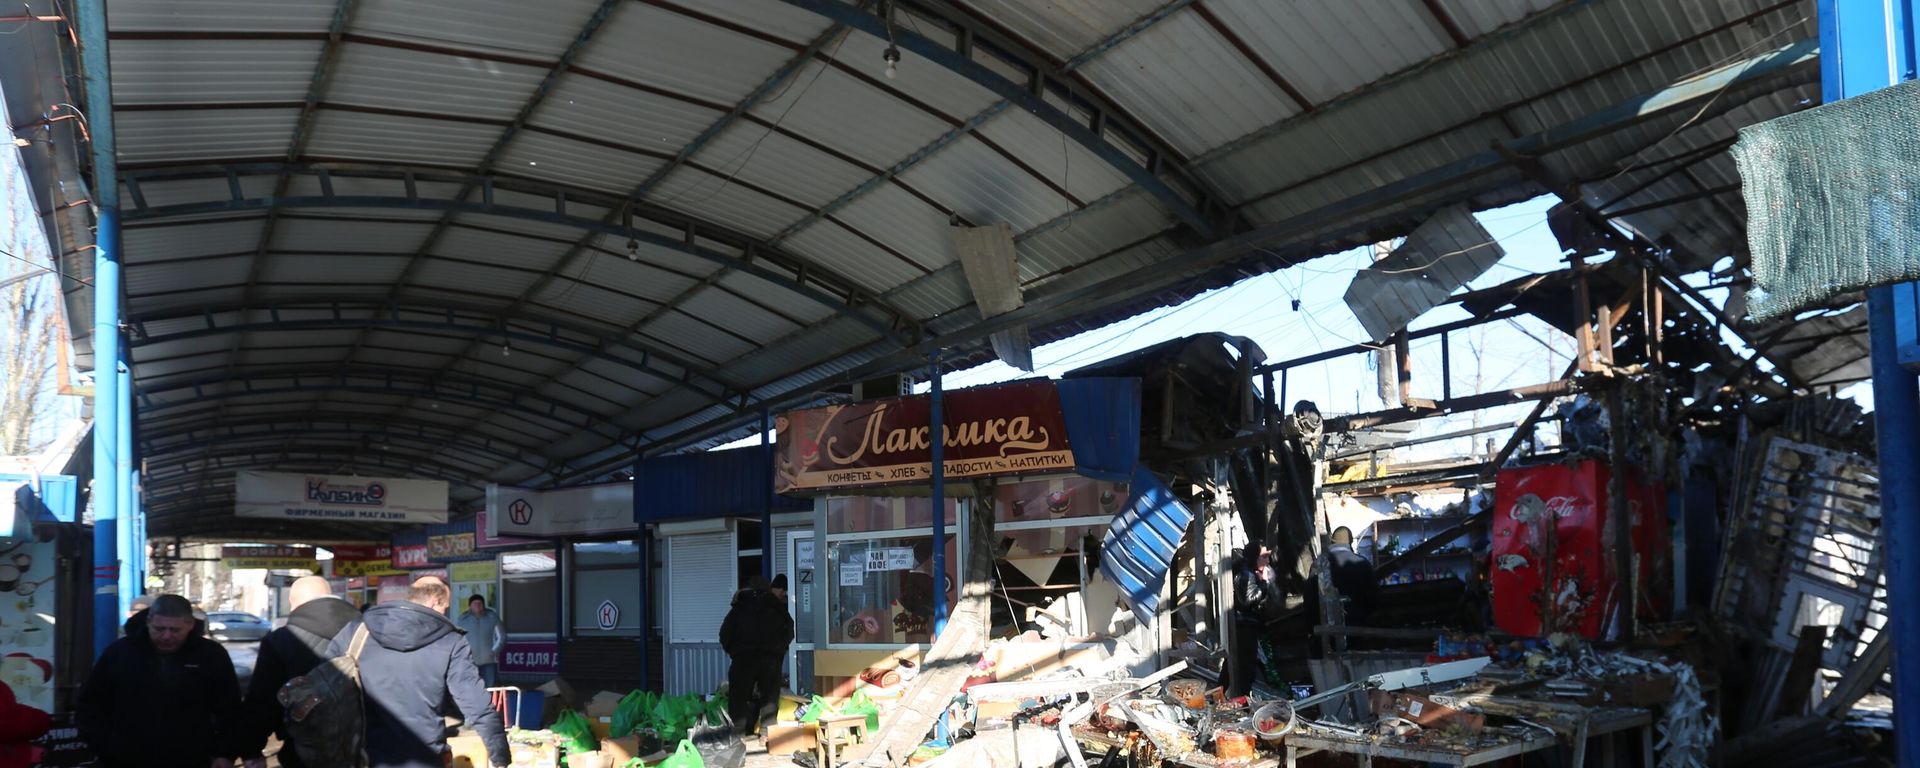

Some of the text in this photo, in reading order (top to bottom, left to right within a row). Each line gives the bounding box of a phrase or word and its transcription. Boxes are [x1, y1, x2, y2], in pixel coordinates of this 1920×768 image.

[827, 470, 872, 484] КОНФЕТЫ
[889, 467, 916, 479] ХЛЕБ
[1009, 453, 1068, 470] НАПИТКИ
[284, 508, 406, 520] ФИРМЕННЫЙ МАГАЗИН
[868, 560, 887, 569] КОФЕ
[506, 652, 524, 665] ВСЕ
[526, 652, 550, 668] ДЛЯ
